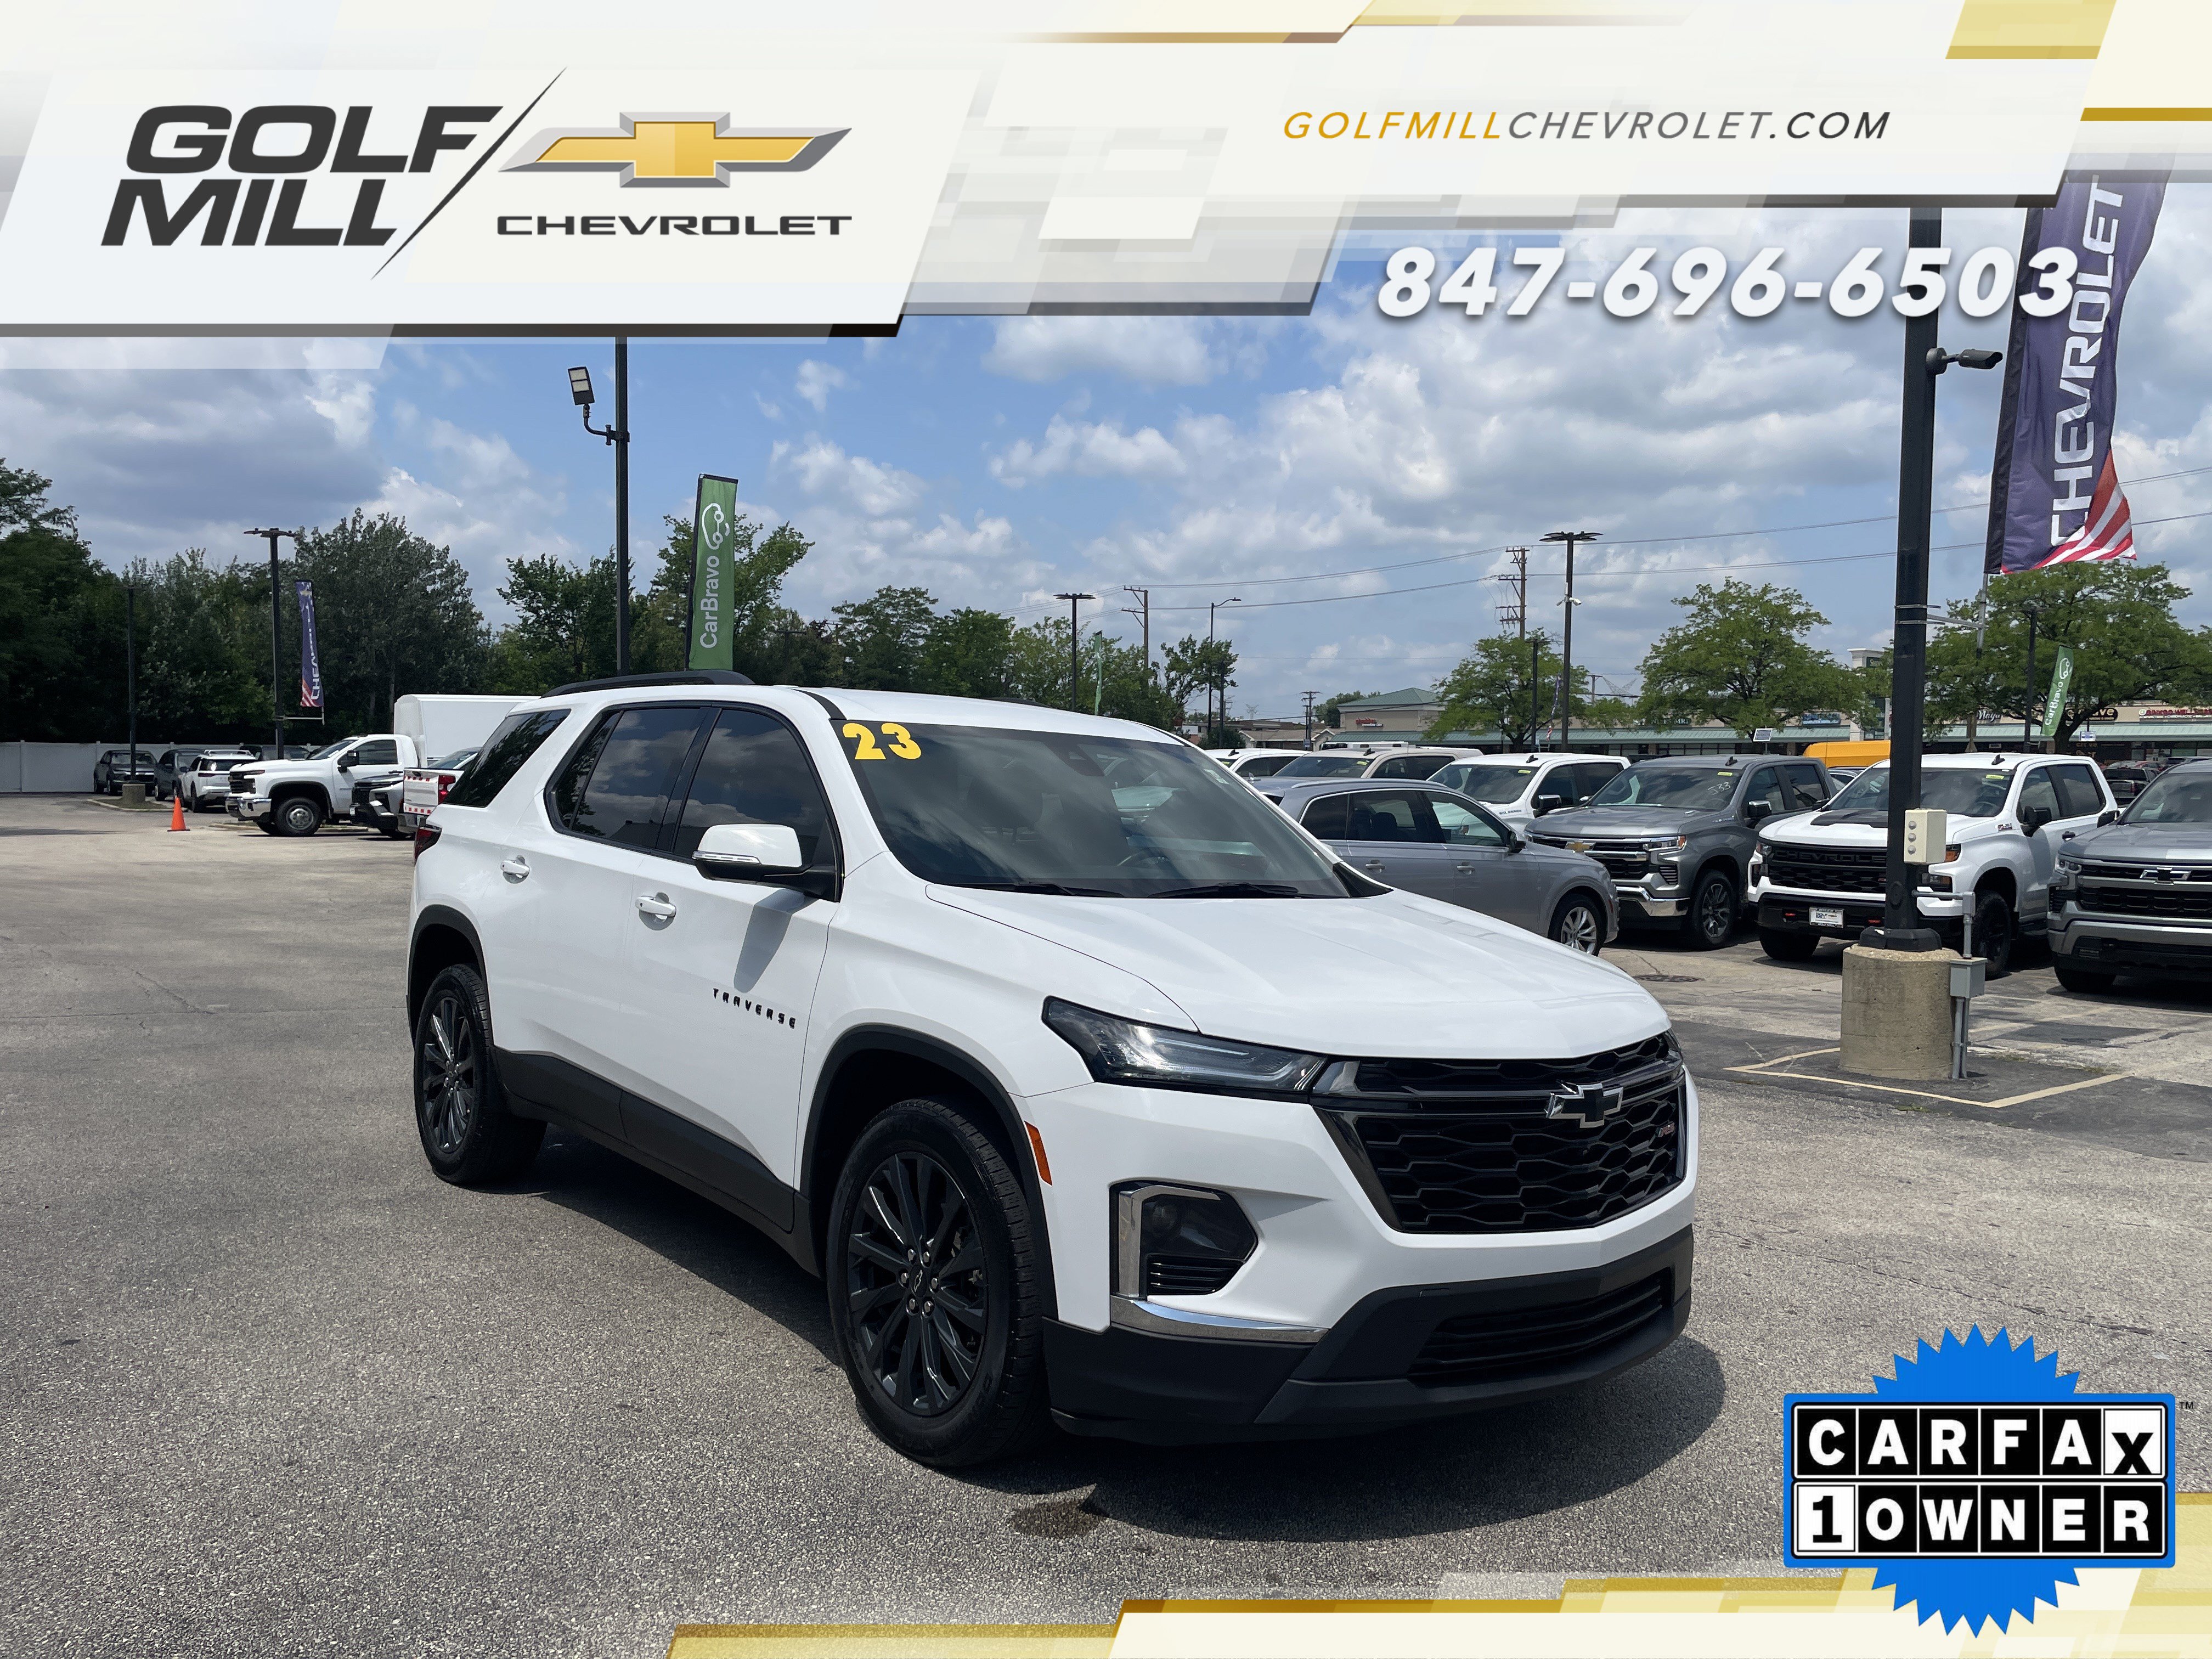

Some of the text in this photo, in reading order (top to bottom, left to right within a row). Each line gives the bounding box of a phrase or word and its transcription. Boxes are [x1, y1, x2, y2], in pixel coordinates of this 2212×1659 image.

[2051, 174, 2124, 547] CHEVROLET
[699, 555, 720, 648] CarBravo
[2045, 681, 2063, 726] CarBravo
[842, 723, 922, 760] 23
[1776, 851, 1887, 864] CHEVROLE
[713, 988, 796, 1030] TRAVERSE
